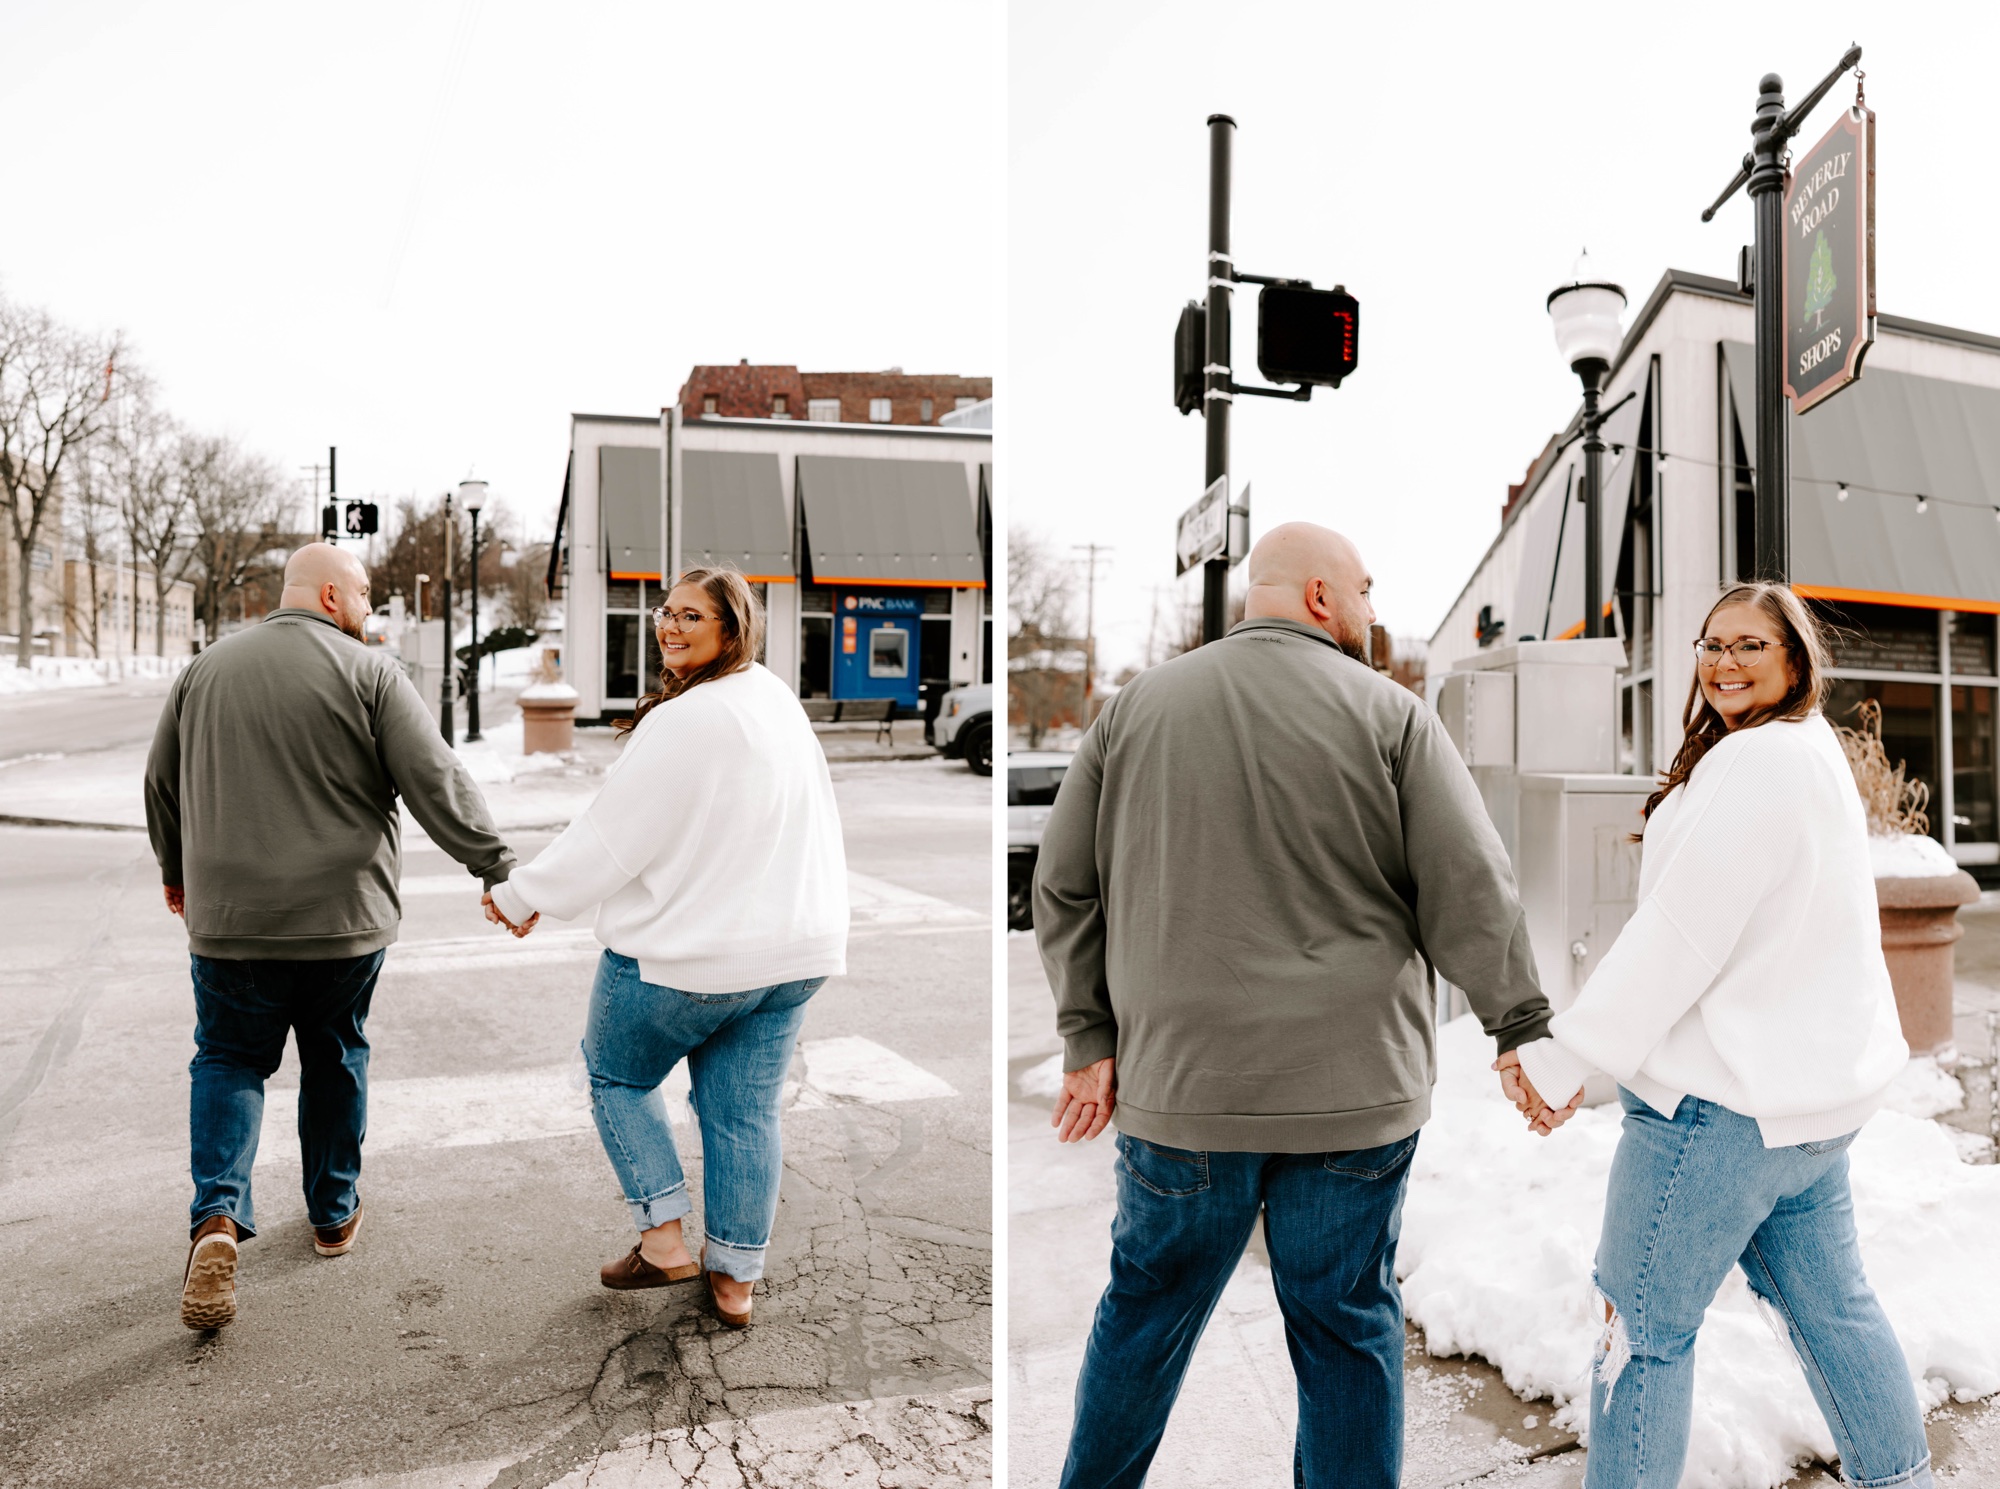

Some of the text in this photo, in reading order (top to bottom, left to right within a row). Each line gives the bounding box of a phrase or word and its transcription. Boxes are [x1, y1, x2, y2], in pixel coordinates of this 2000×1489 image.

[1791, 152, 1851, 226] BEVERLY
[1802, 187, 1839, 238] ROAD
[1799, 327, 1841, 375] SHOPS
[858, 597, 917, 610] PNC BANK
